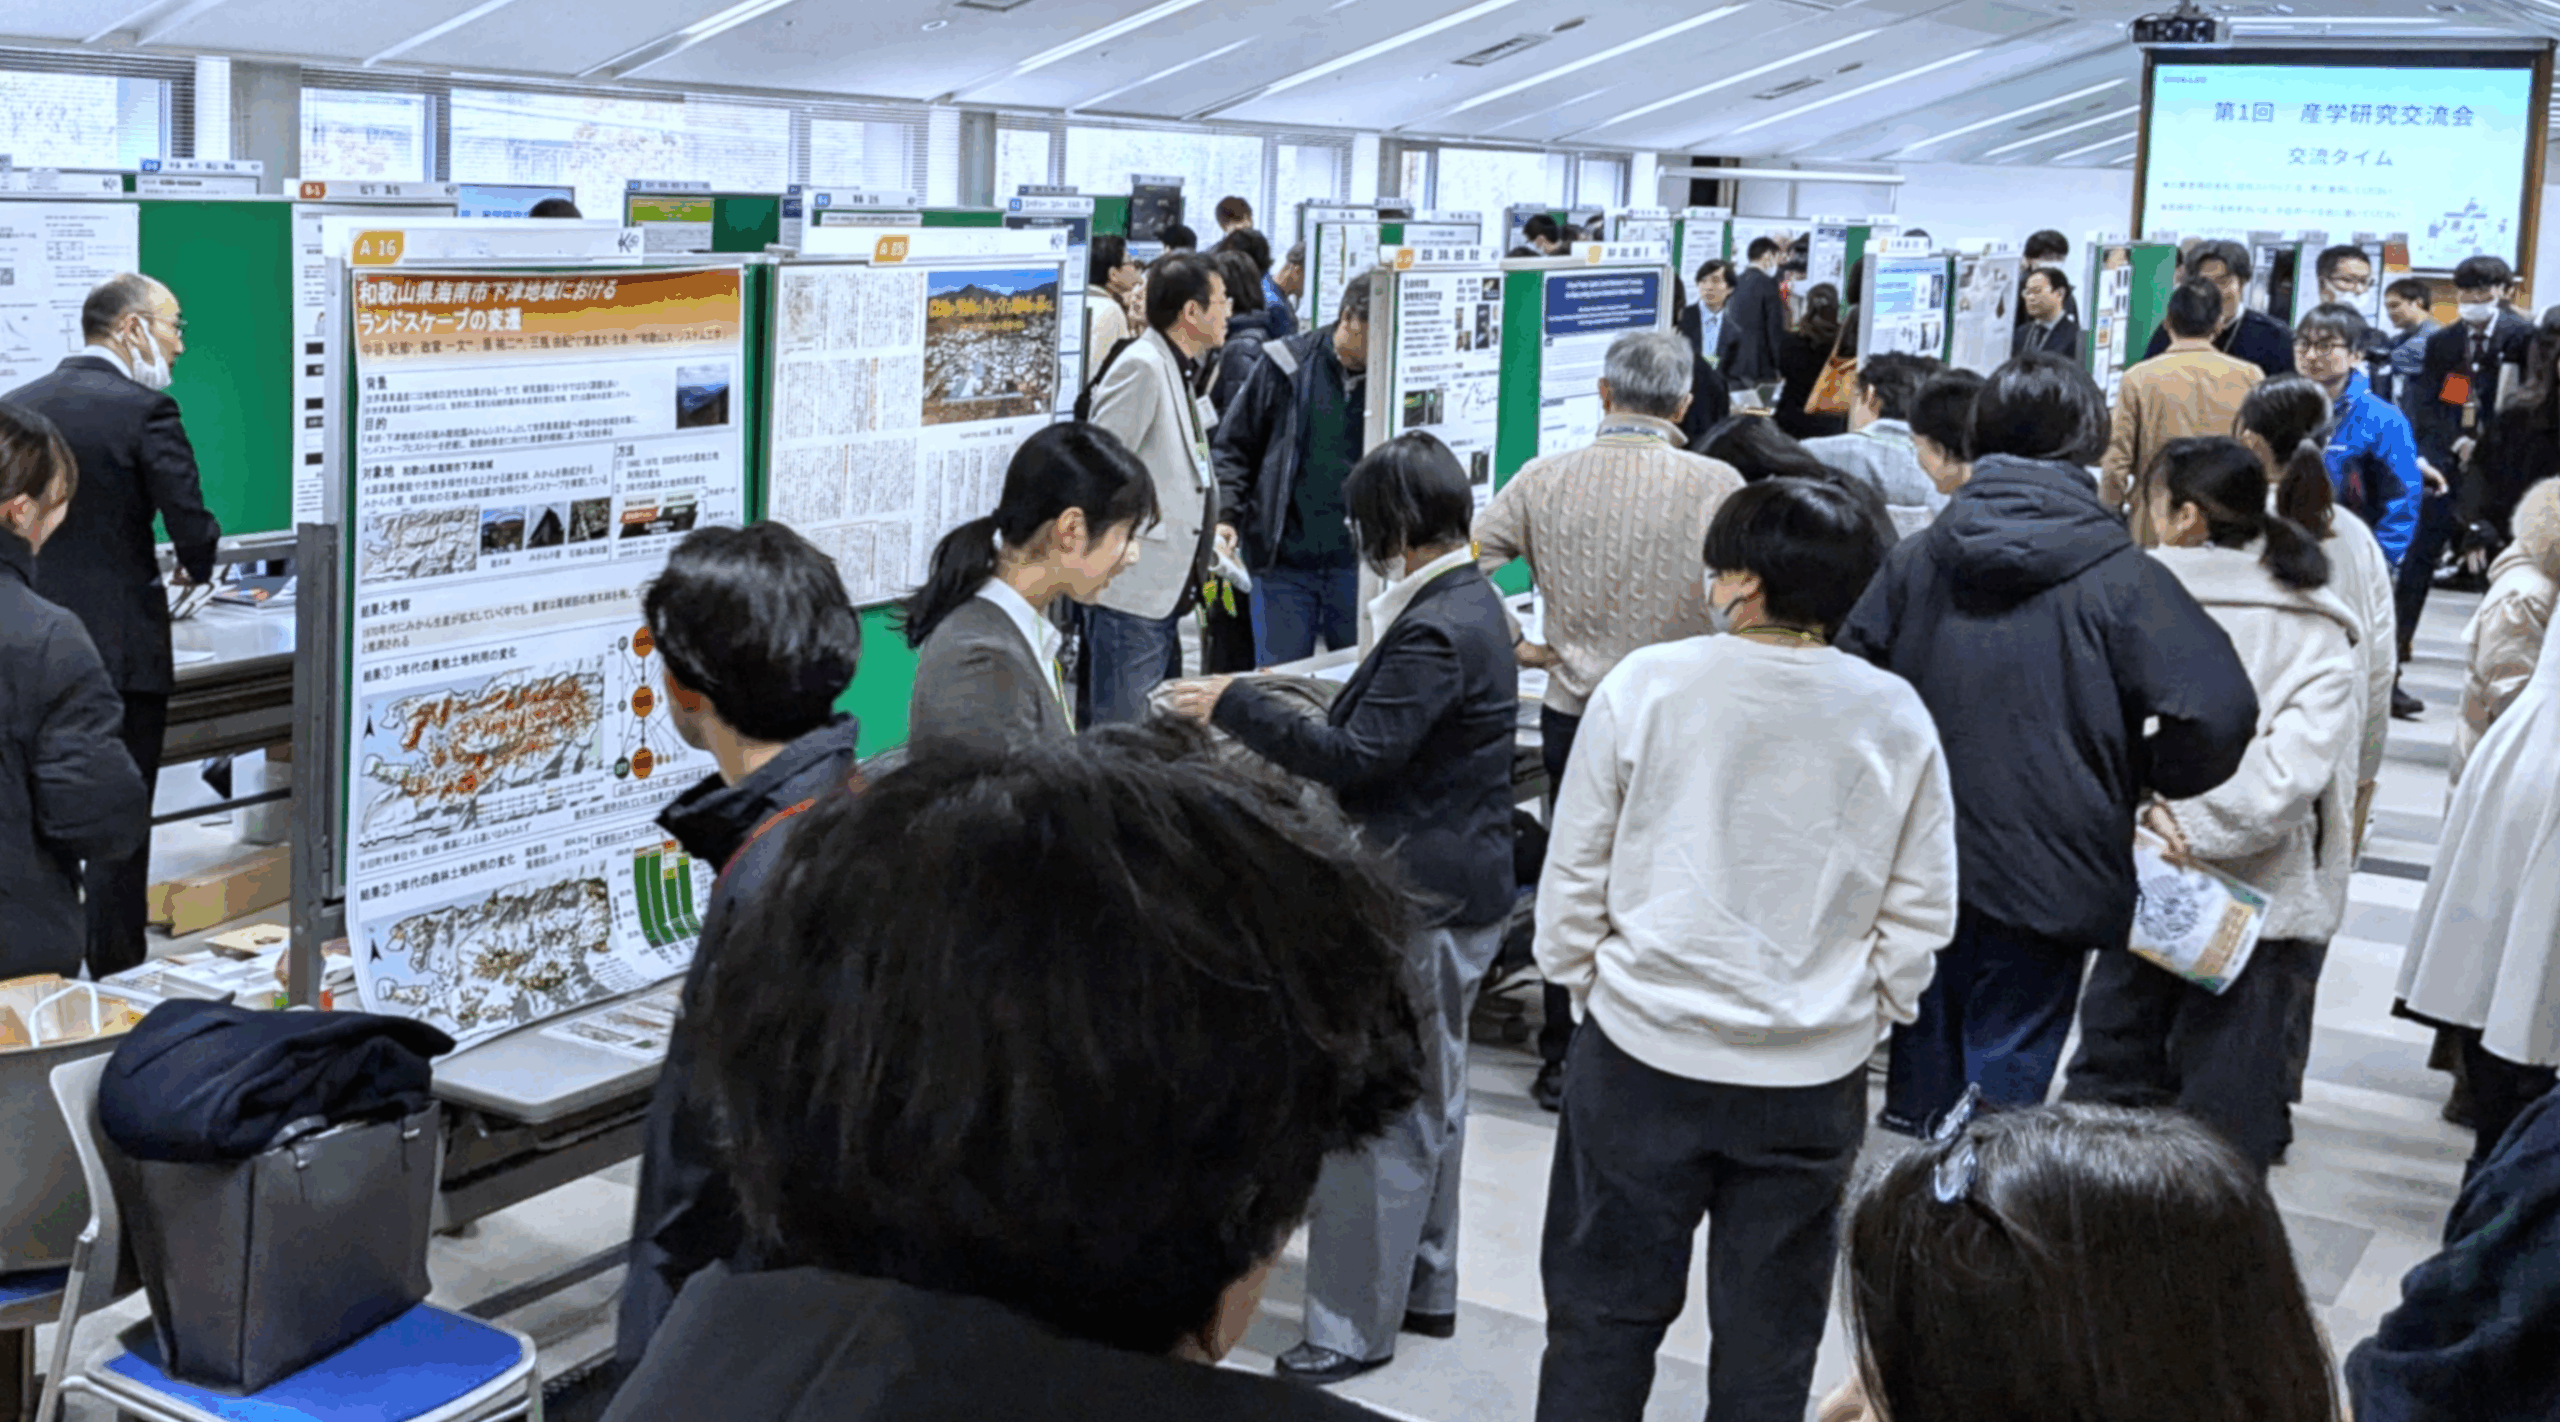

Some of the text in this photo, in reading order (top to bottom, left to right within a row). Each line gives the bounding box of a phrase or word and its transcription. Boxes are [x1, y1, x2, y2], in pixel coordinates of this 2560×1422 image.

[2215, 101, 2475, 127] 第1回 産学研究交流会
[2288, 147, 2394, 167] 交流タイム
[359, 279, 618, 306] 和歌山県海南市下津地域における
[359, 308, 523, 335] ランドスケープの変遷
[365, 417, 388, 431] 目的
[617, 444, 635, 458] 方法
[363, 459, 494, 481] 対象地 和歌山県海南市下津地域
[361, 597, 411, 619] 結果と考察
